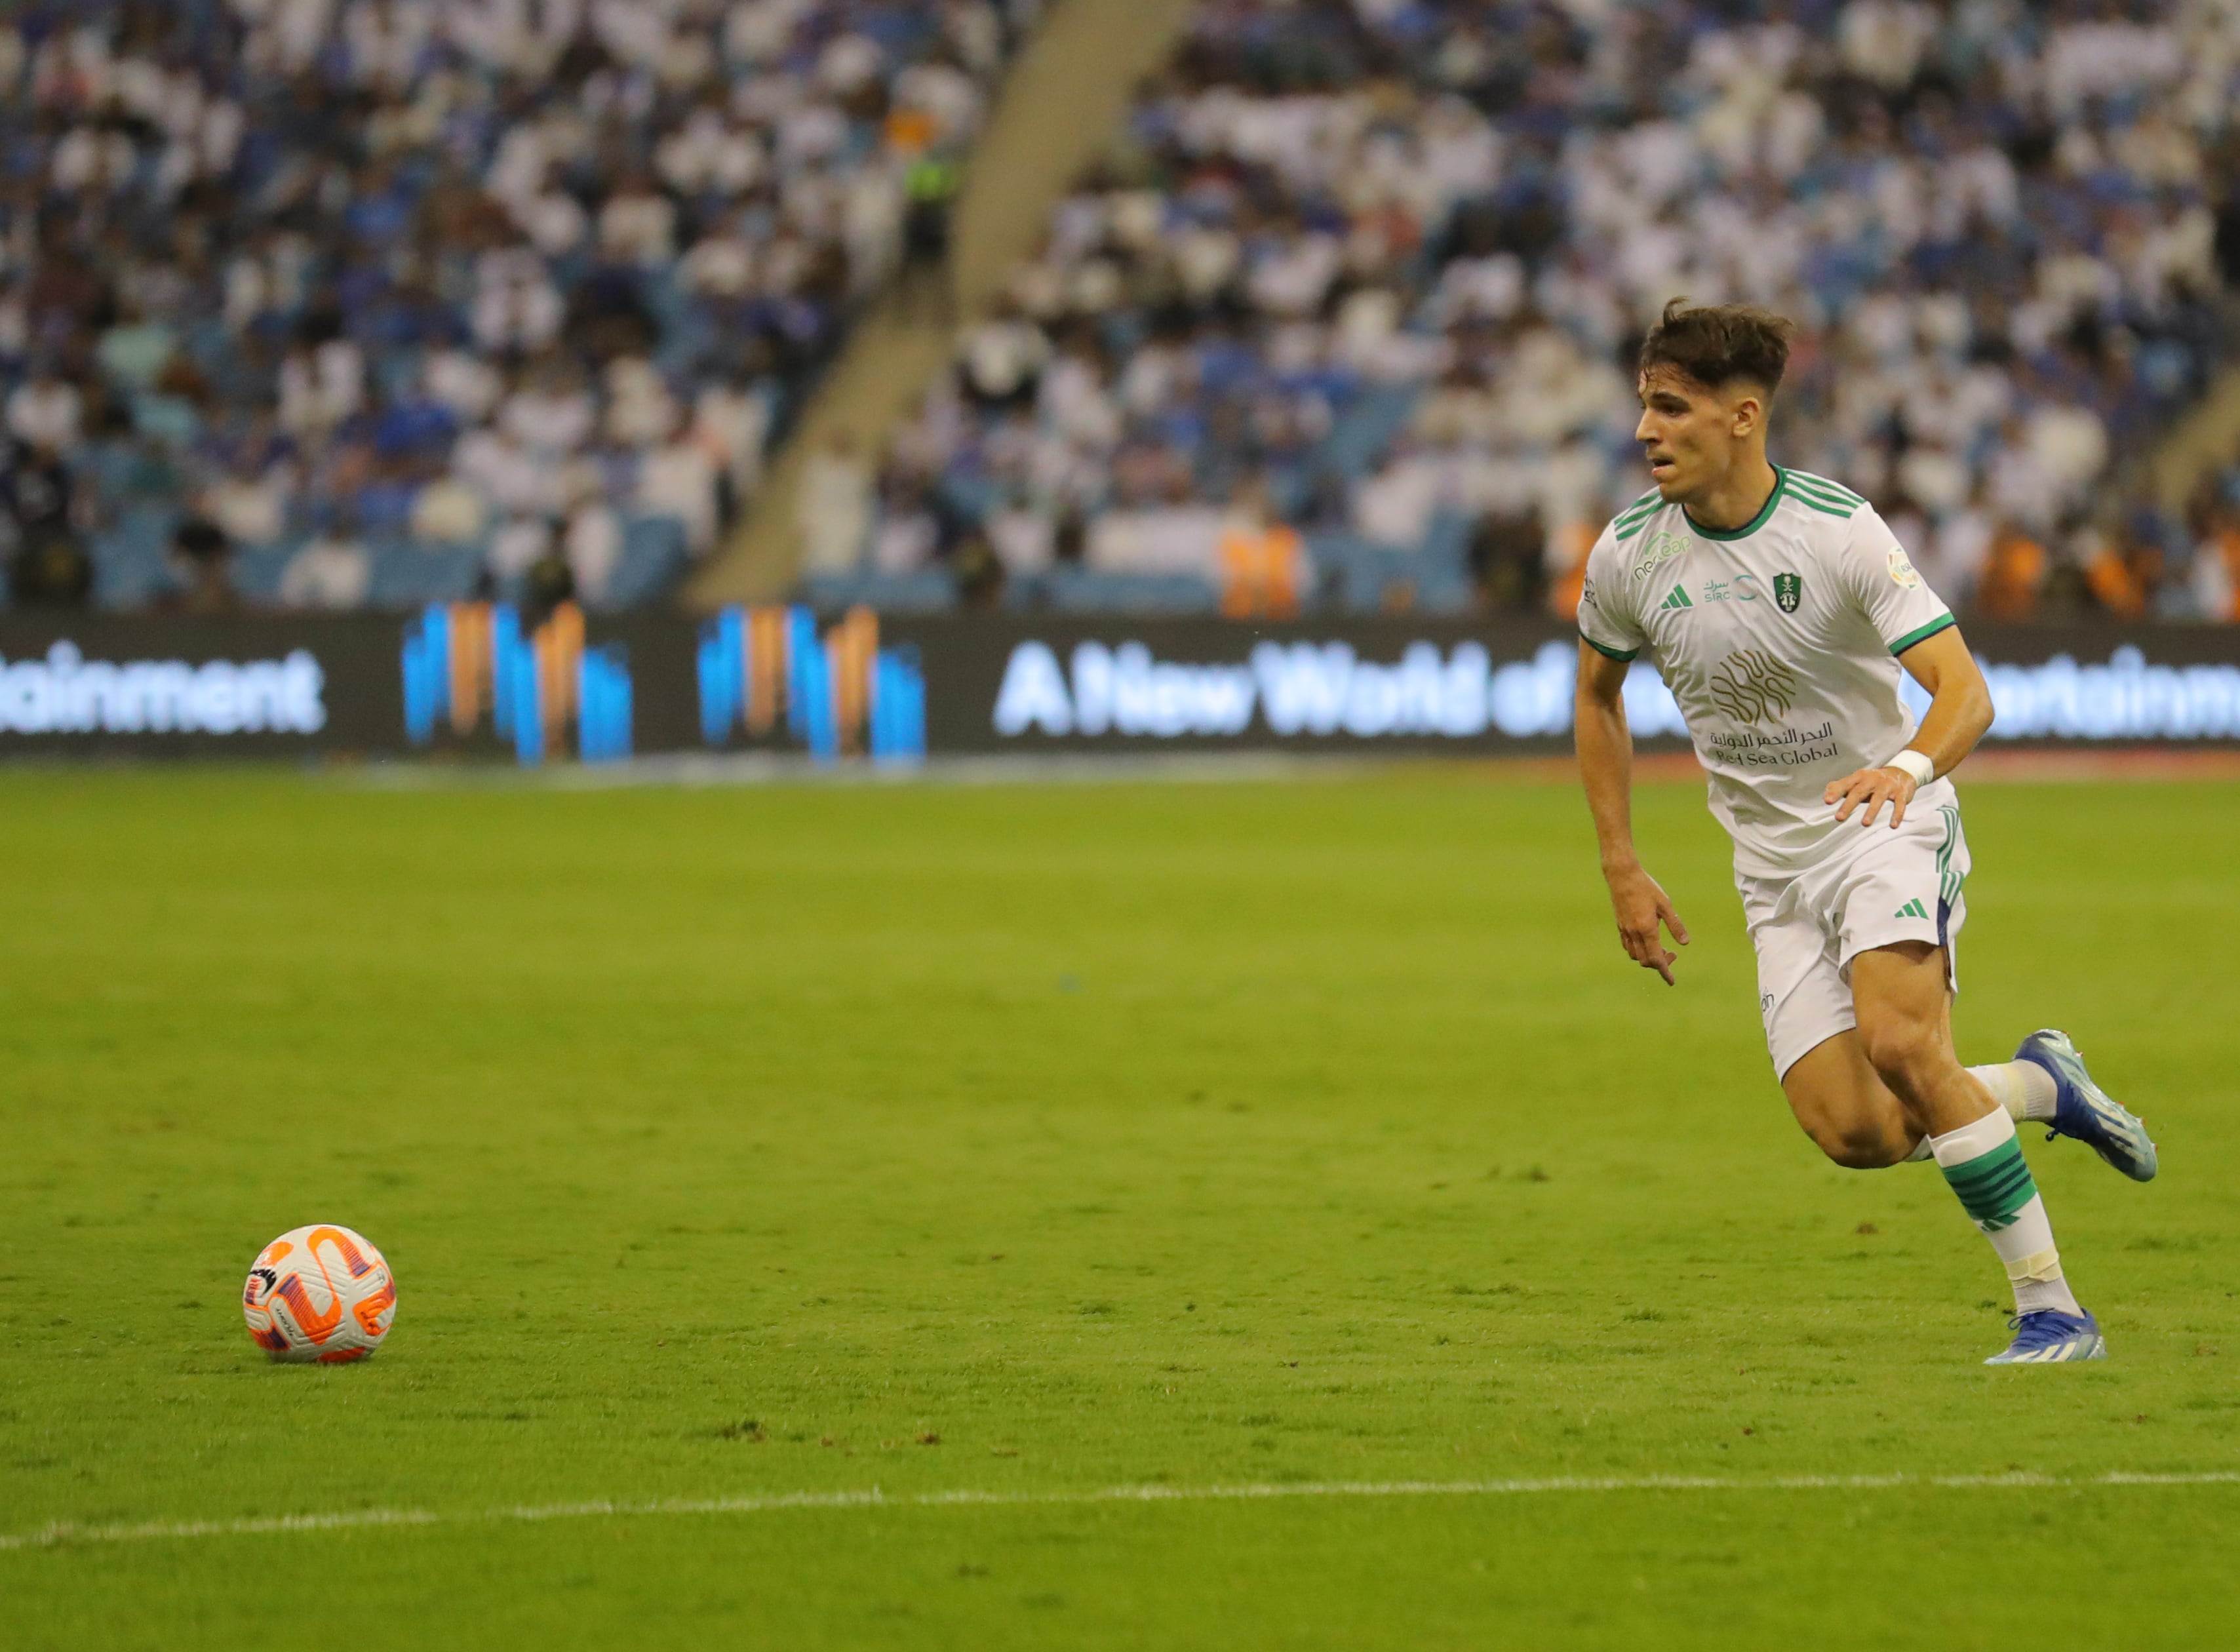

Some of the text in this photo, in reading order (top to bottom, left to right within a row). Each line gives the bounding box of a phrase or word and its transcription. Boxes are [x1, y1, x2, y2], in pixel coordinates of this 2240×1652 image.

[1704, 591, 1731, 602] SIRC
[0, 640, 326, 735] ainment
[991, 639, 1071, 736] A
[1072, 639, 1252, 737] New
[1249, 639, 1491, 737] World
[1757, 728, 1798, 749] الأحمر
[1800, 722, 1834, 745] البحر
[1716, 743, 1839, 766] Red Sea Global
